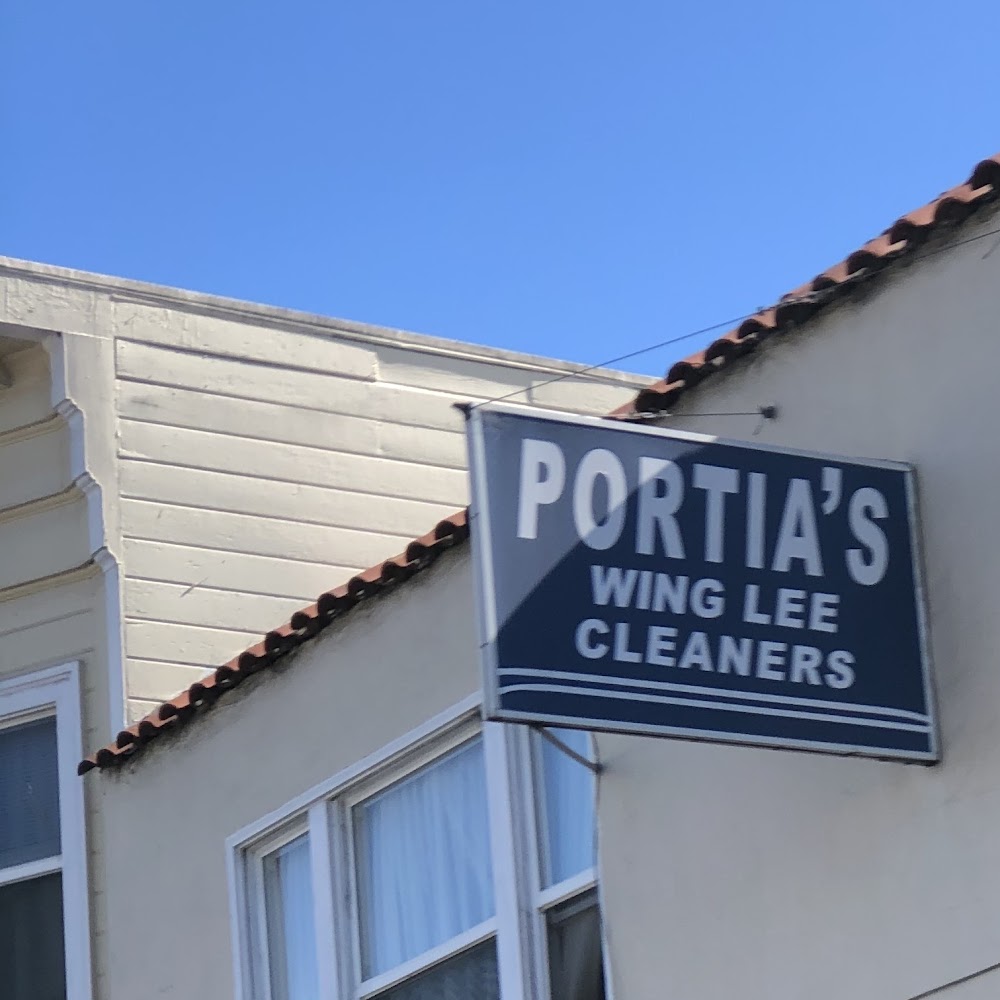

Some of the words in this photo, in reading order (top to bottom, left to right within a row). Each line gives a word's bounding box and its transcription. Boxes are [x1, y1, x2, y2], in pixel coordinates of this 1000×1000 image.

[516, 438, 889, 586] PORTIA'S
[590, 564, 725, 619] WING
[743, 583, 841, 634] LEE
[574, 618, 857, 690] CLEANERS
